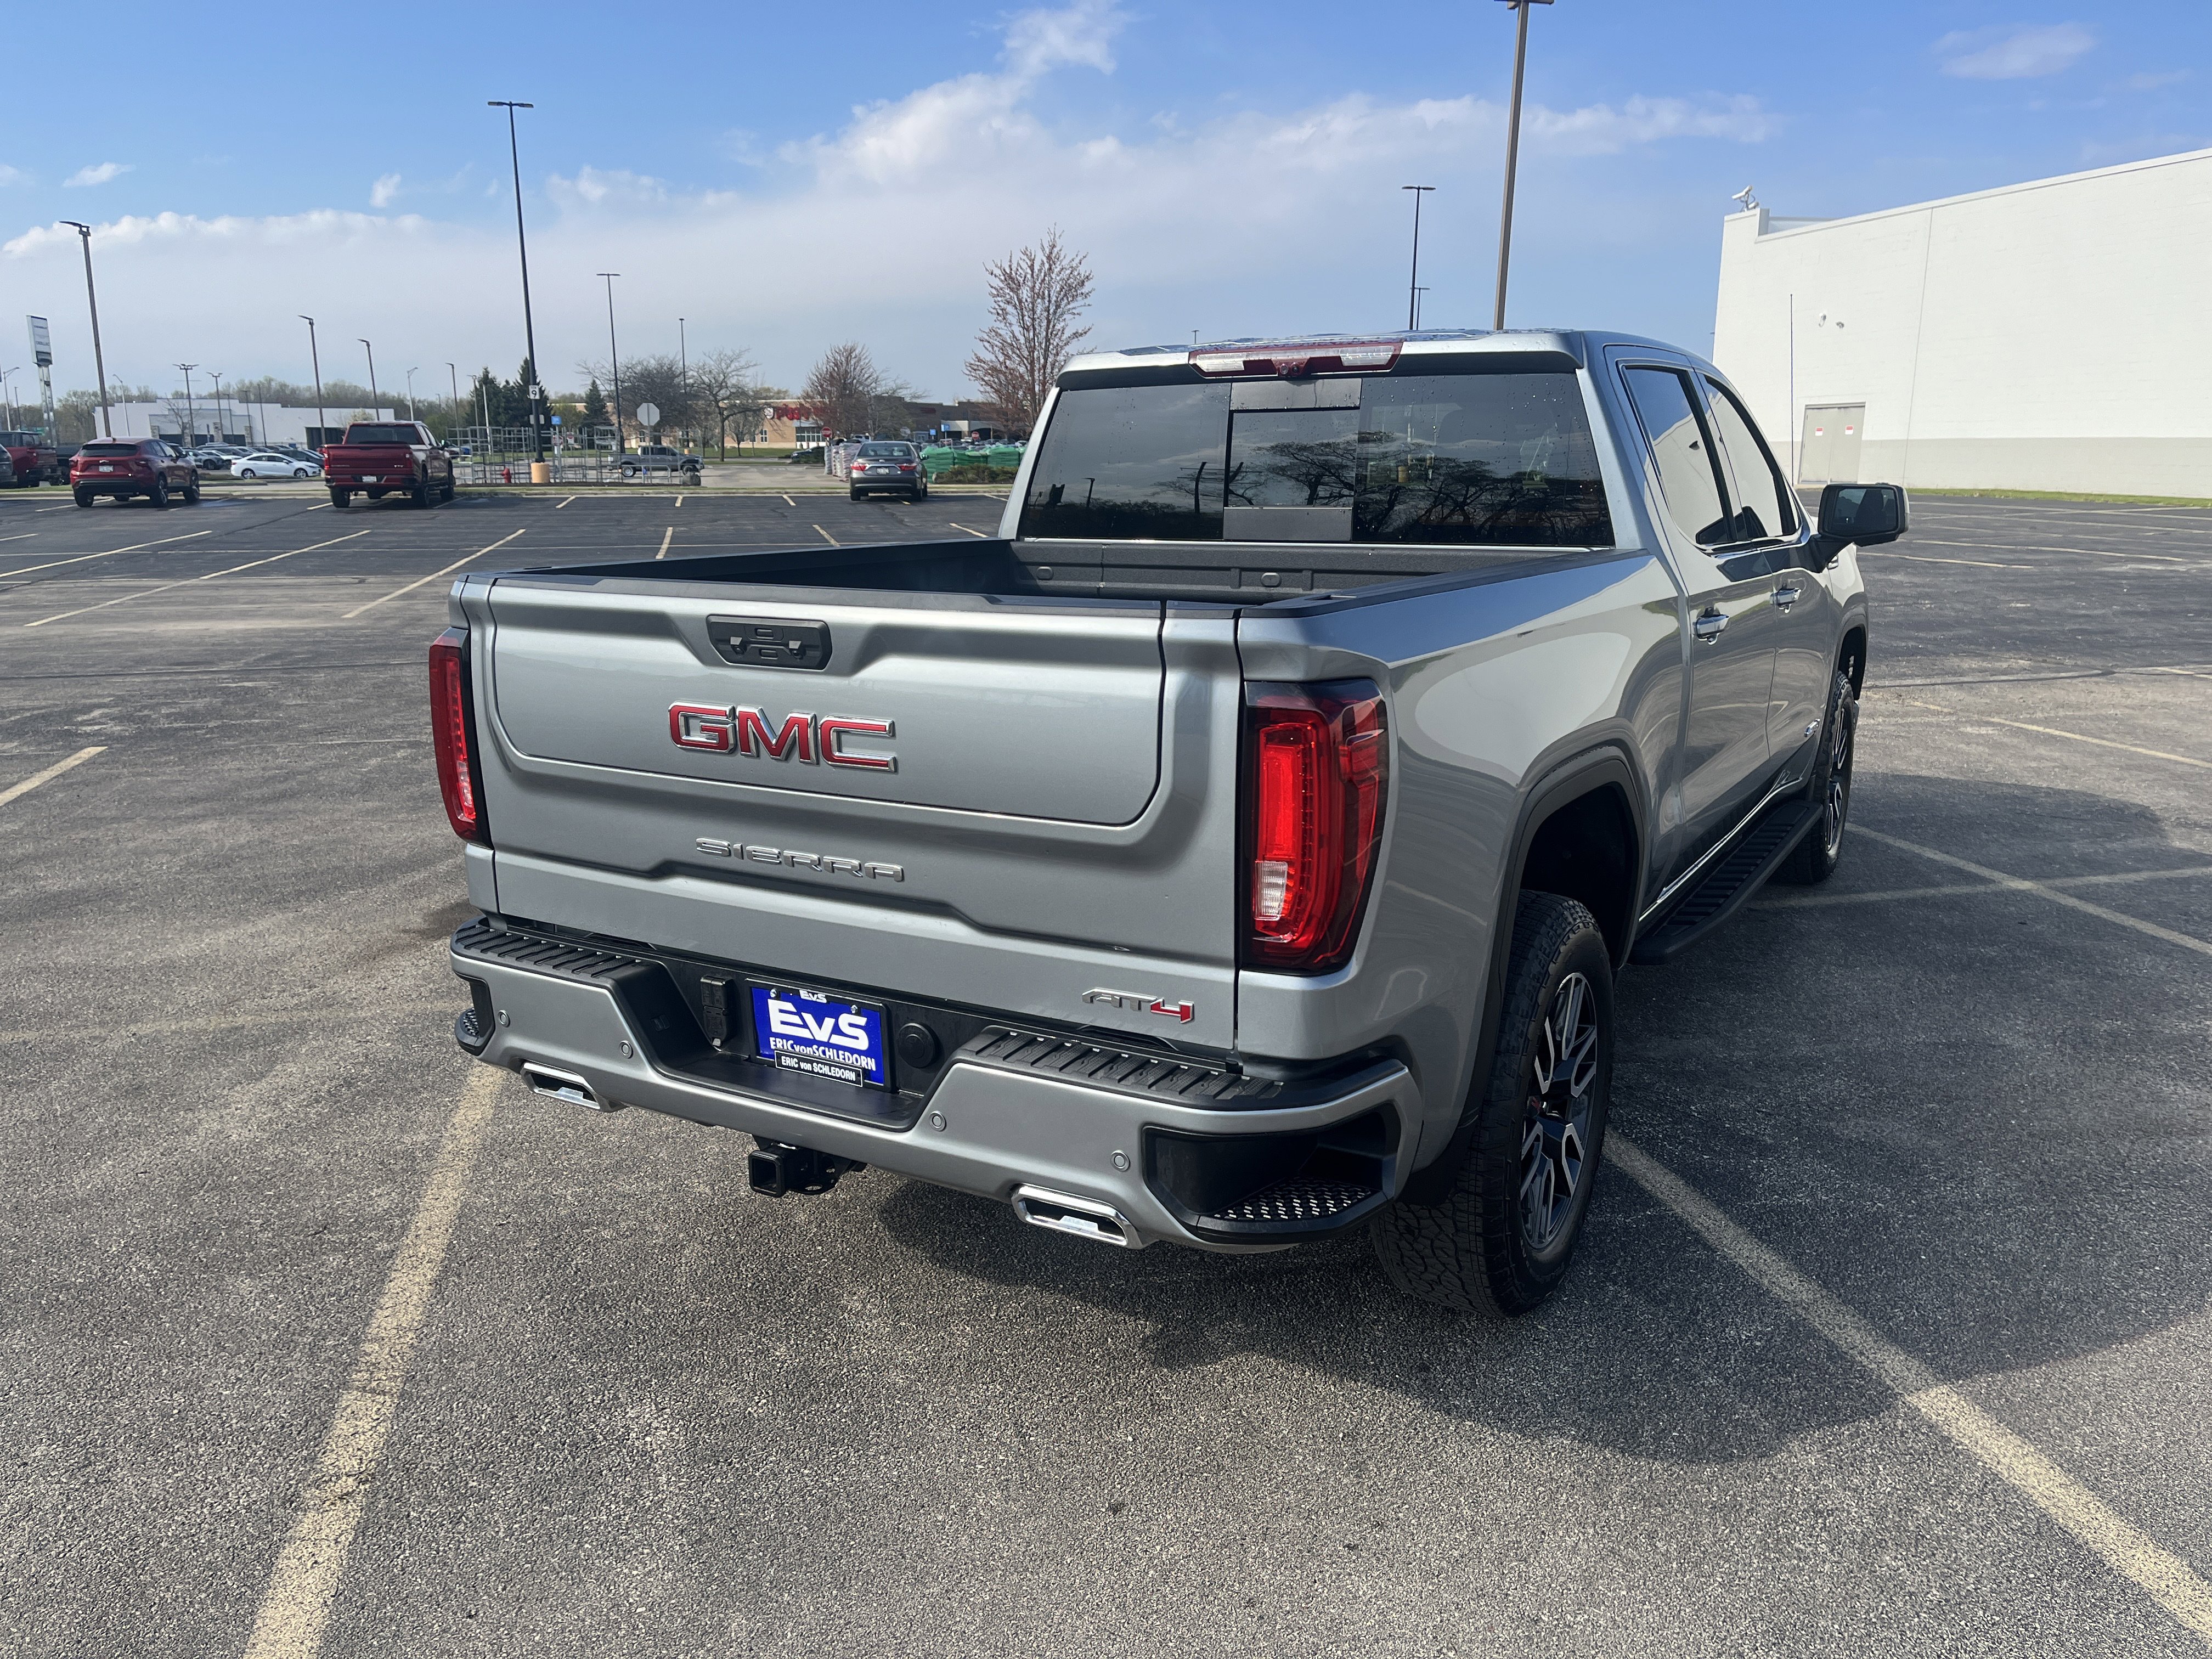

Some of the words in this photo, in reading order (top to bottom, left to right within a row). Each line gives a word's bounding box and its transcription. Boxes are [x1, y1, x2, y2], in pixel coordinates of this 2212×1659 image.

[532, 390, 537, 398] 9
[668, 701, 899, 774] GMC
[696, 837, 905, 882] SIERRA
[1082, 987, 1195, 1024] AT4
[781, 1056, 799, 1068] ERIC
[799, 1061, 812, 1071] von
[813, 1063, 856, 1081] SCHLEDORN
